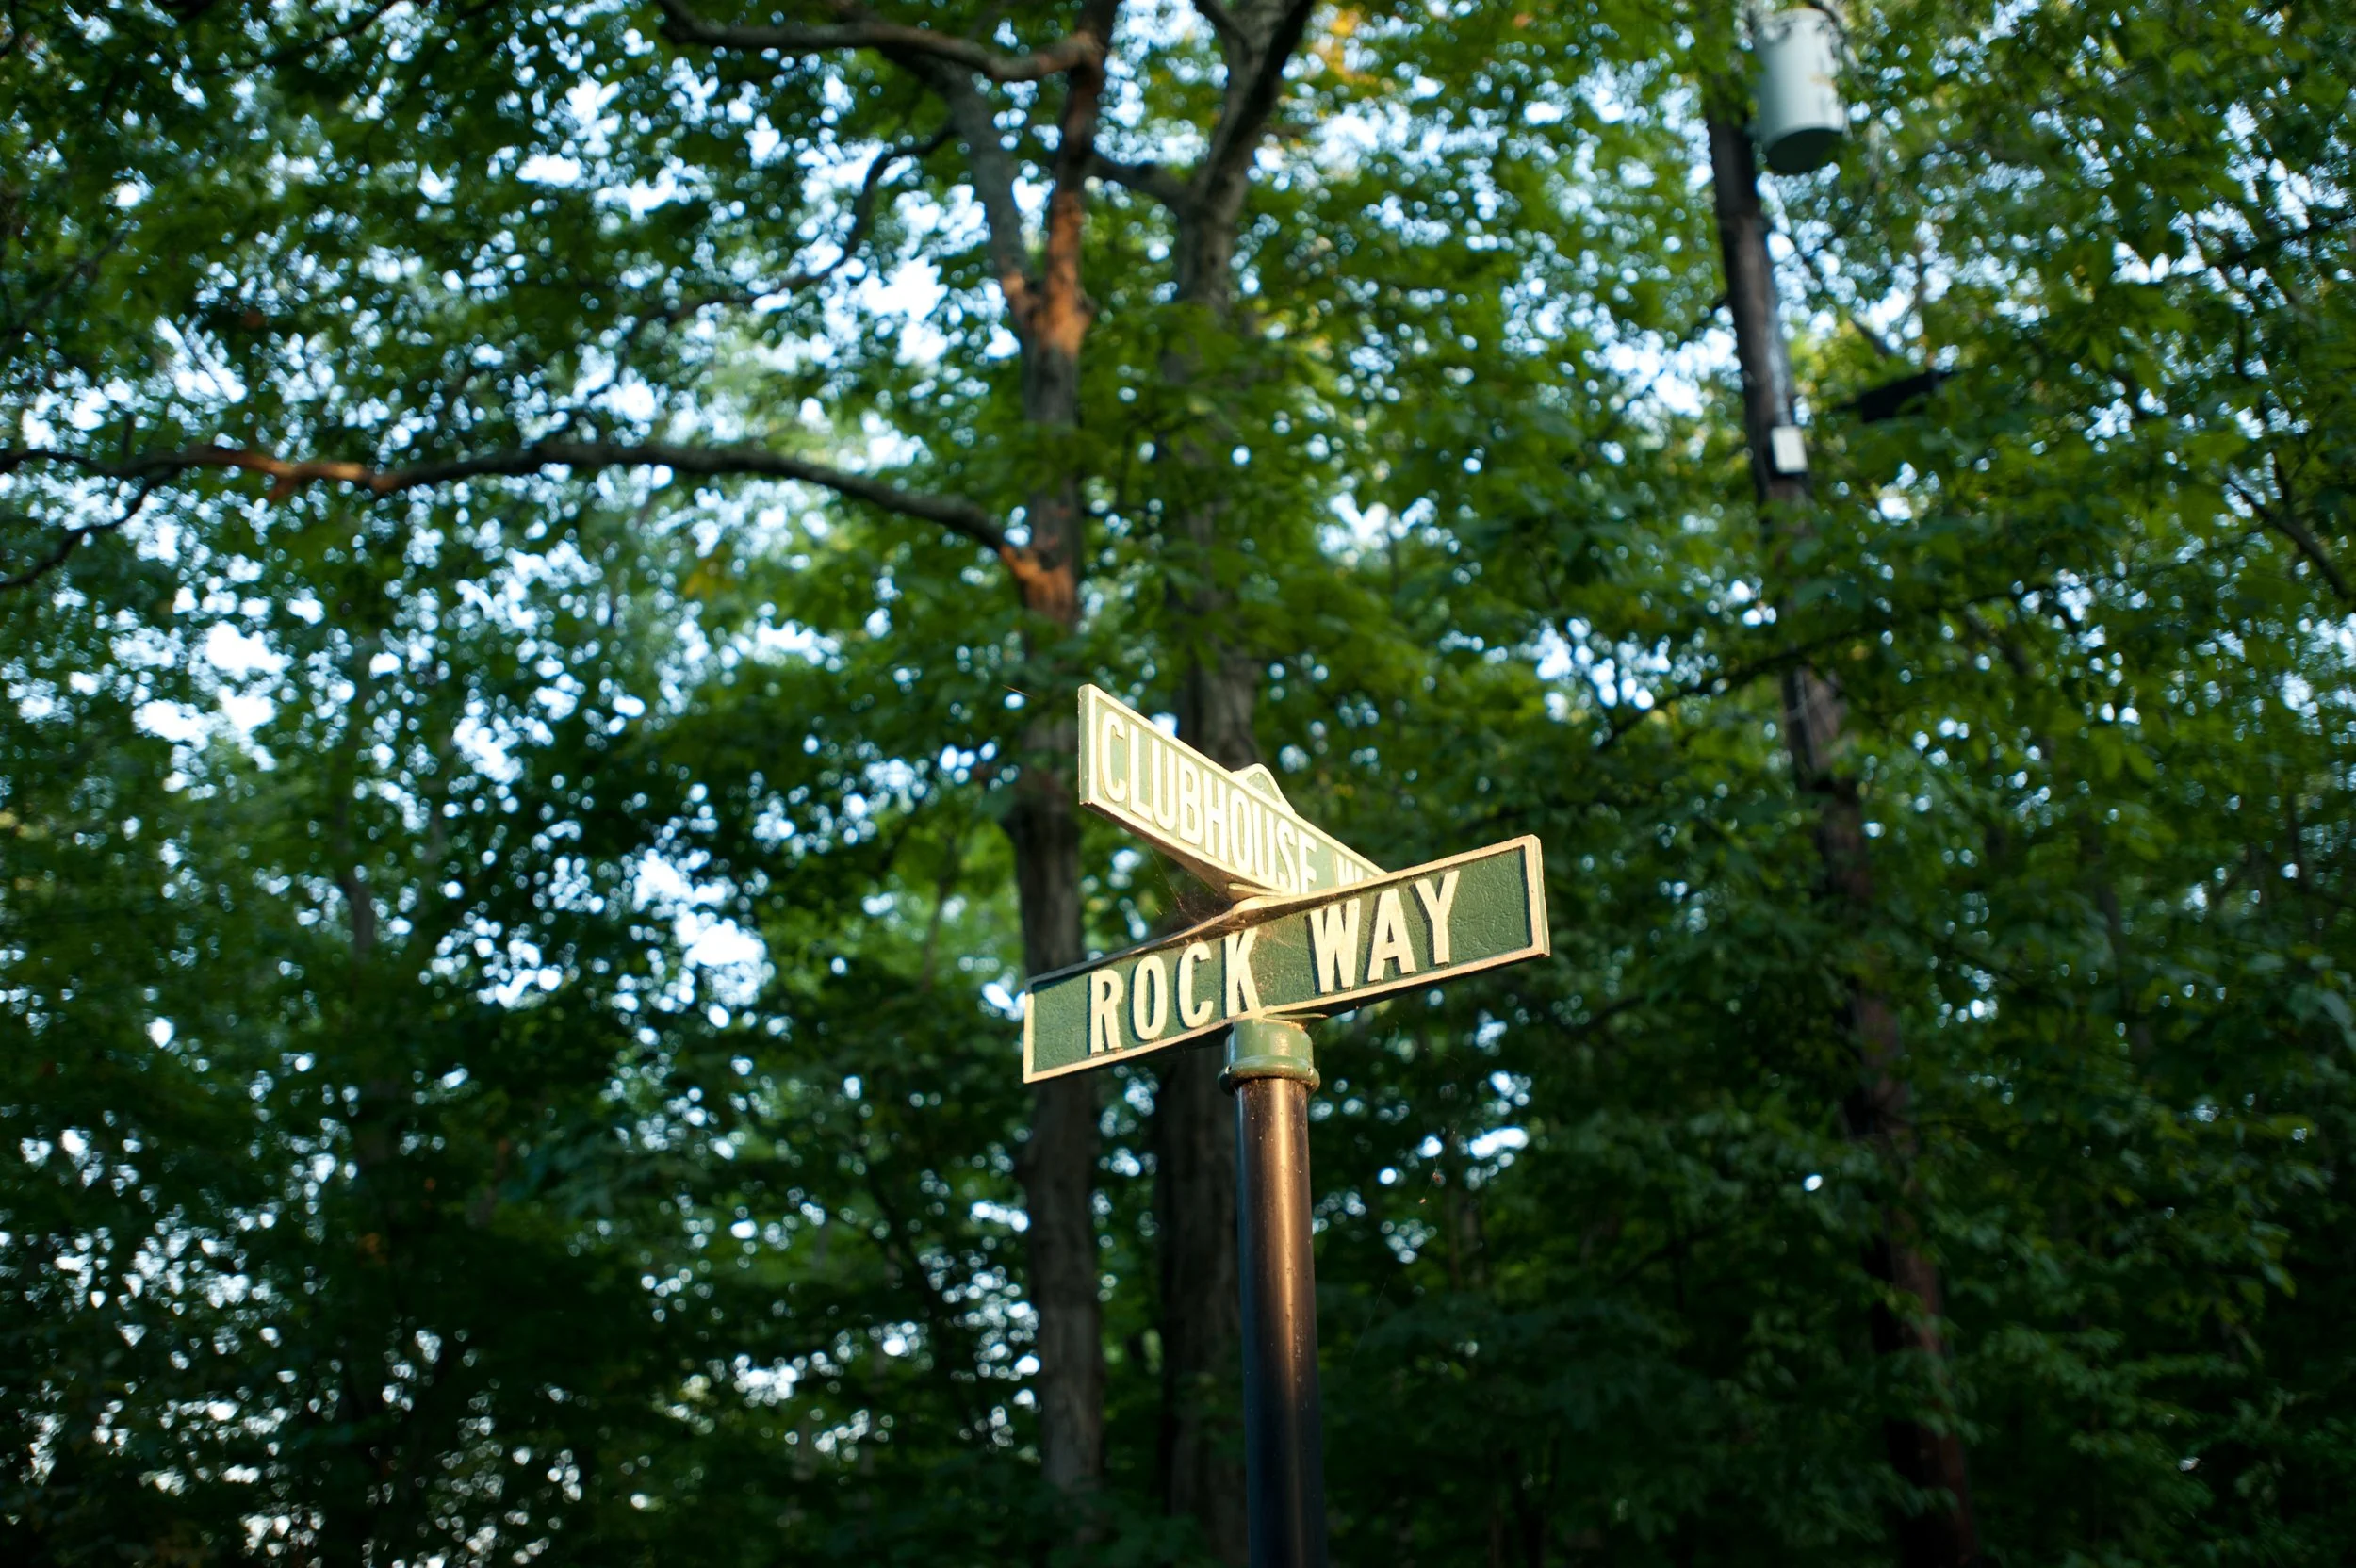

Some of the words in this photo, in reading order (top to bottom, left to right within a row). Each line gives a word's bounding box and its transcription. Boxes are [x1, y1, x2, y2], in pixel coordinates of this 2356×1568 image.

[1099, 710, 1317, 894] CLUBHOUSE
[1088, 928, 1261, 1054] ROCK
[1311, 870, 1460, 994] WAY
